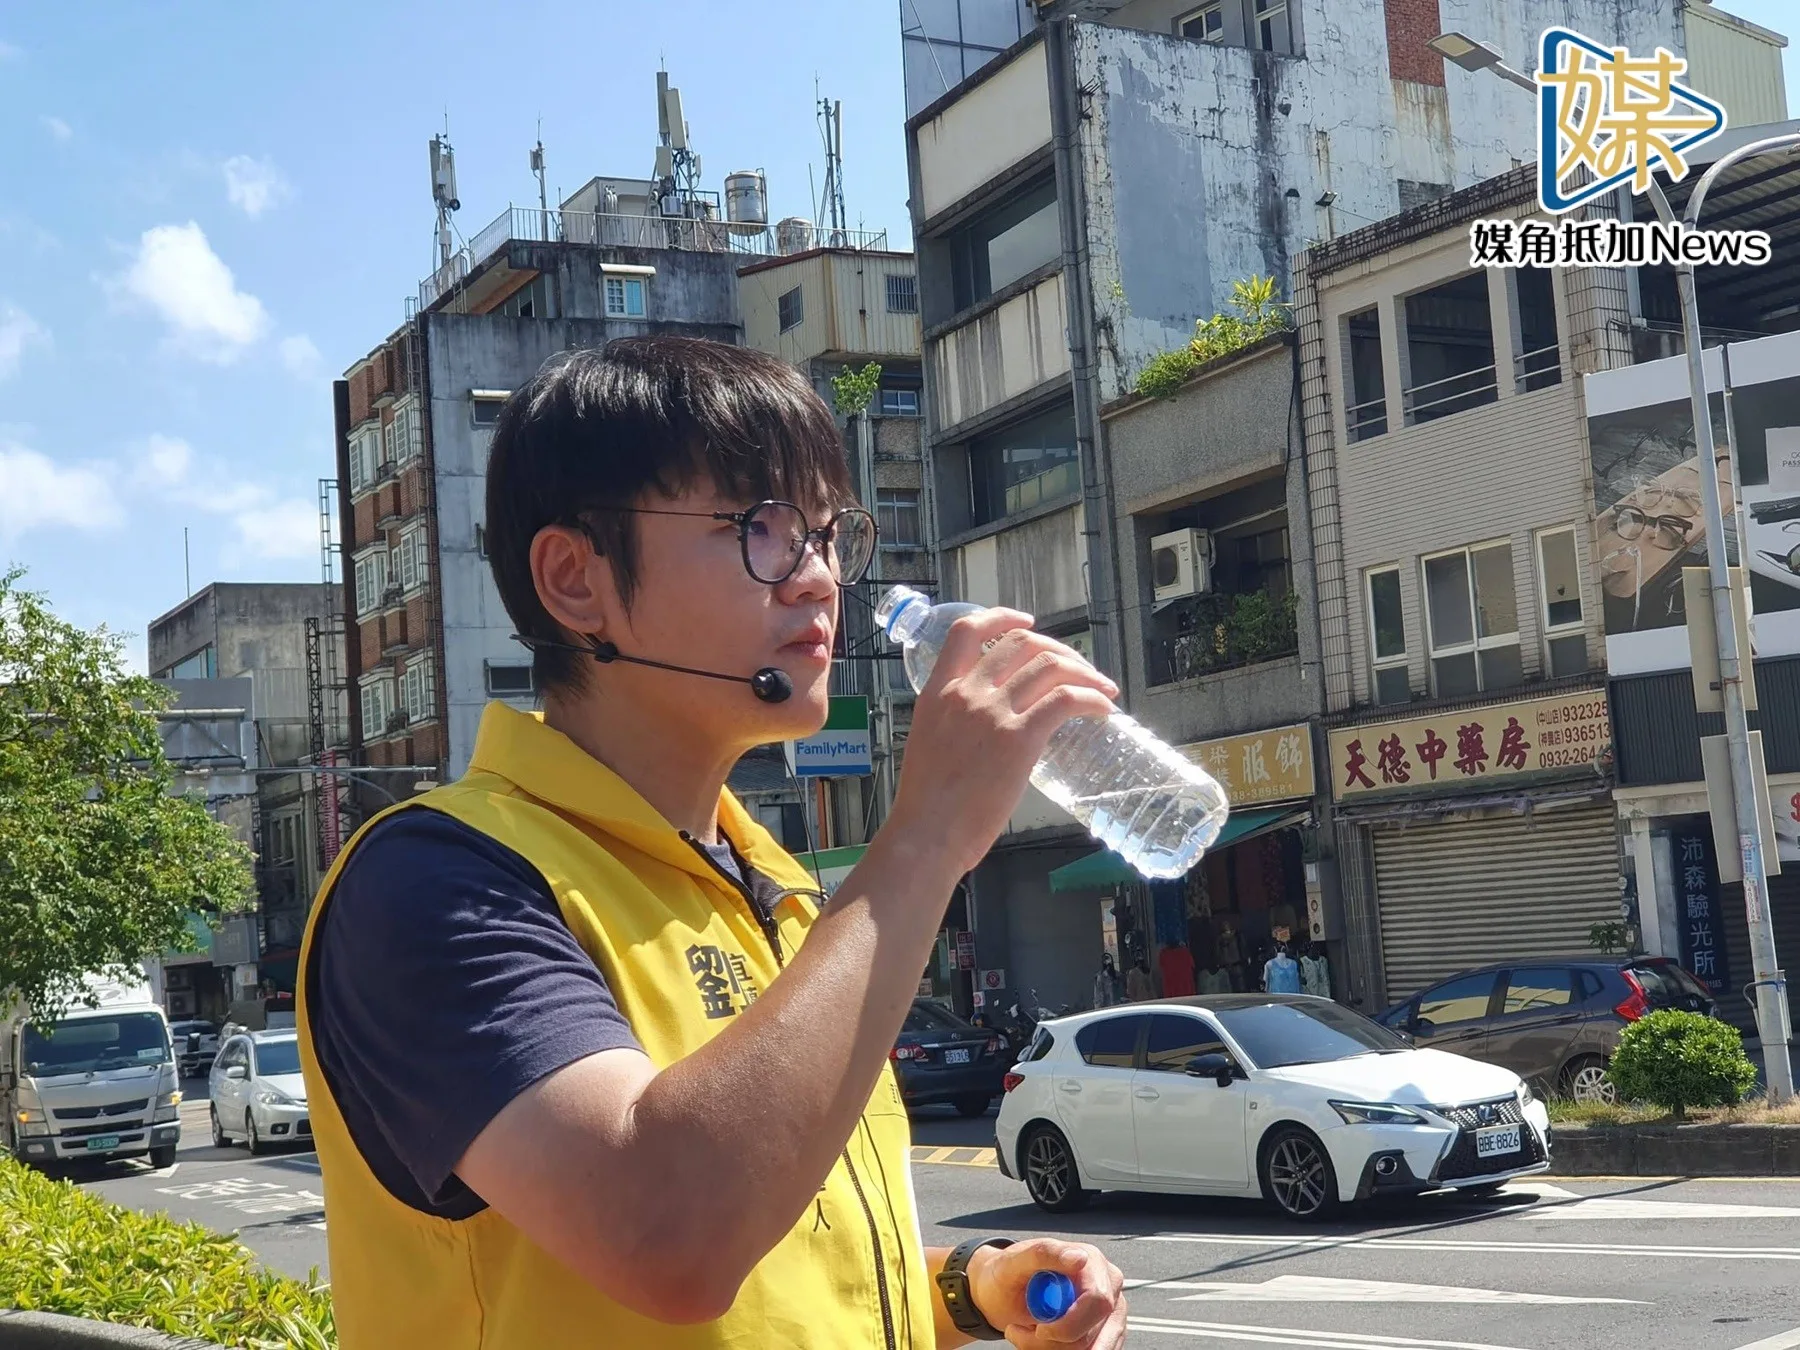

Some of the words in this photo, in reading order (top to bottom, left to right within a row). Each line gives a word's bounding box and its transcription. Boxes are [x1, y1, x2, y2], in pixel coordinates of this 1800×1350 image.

[796, 742, 867, 757] FamilyMart
[1243, 733, 1303, 783] 服飾
[1345, 716, 1532, 789] 天德中藥房
[1680, 836, 1716, 976] 沛森驗光所
